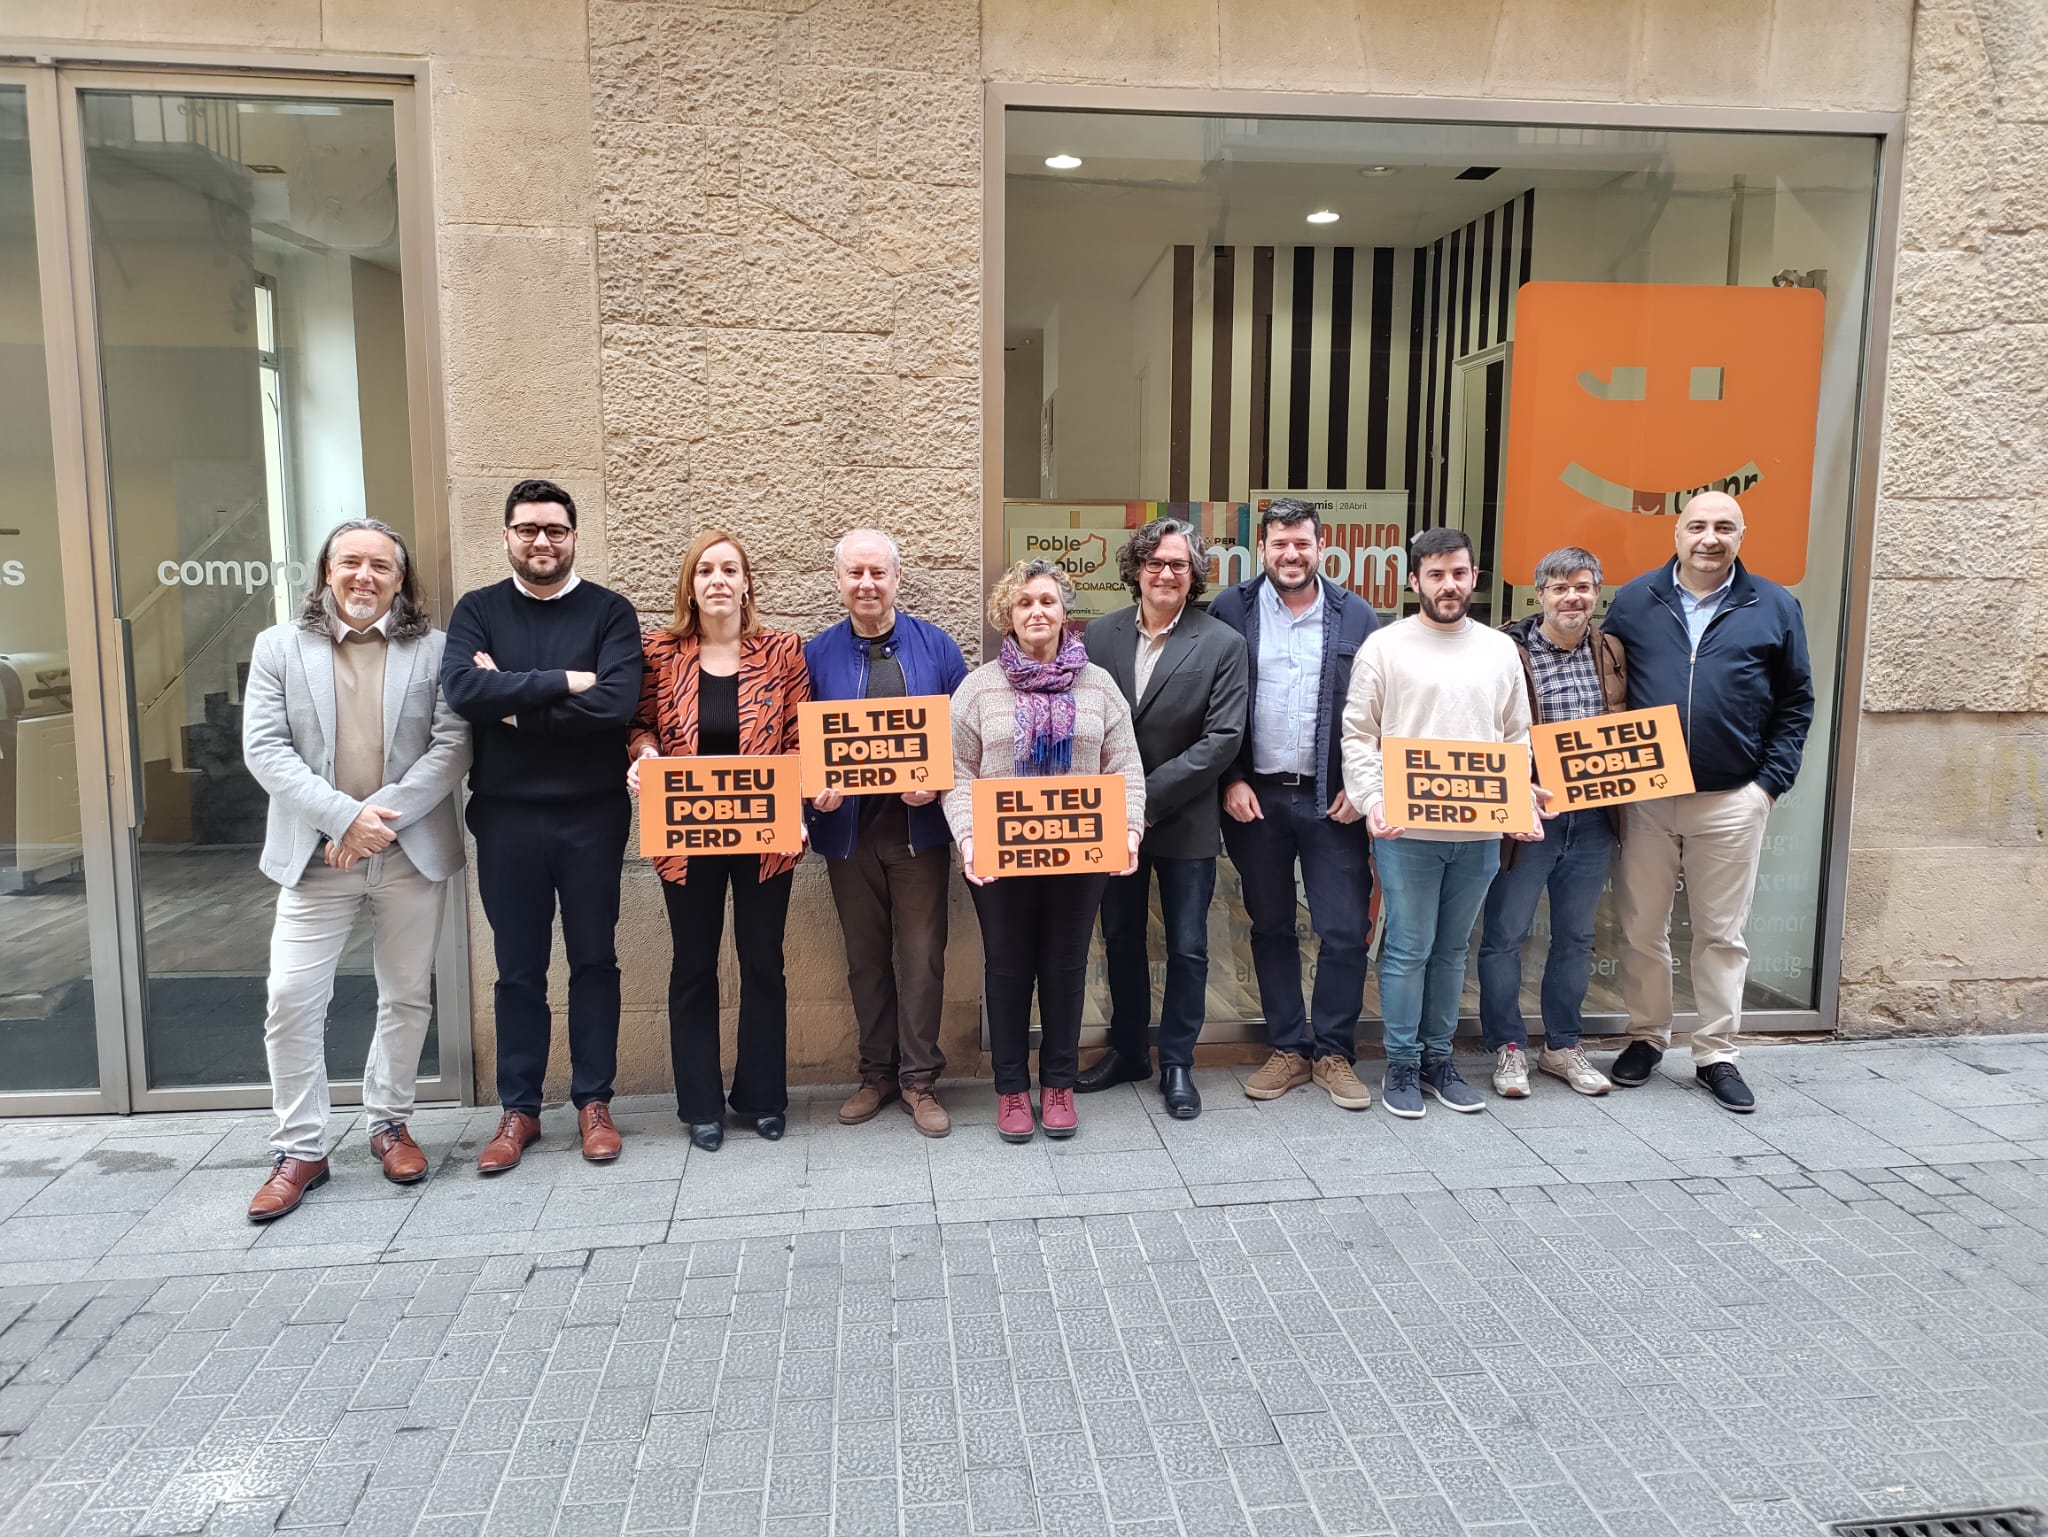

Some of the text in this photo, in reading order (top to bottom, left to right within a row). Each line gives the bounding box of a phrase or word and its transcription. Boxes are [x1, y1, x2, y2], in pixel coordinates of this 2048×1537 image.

[1026, 535, 1081, 551] Poble
[1214, 537, 1236, 545] PER
[0, 559, 26, 586] s
[157, 559, 313, 595] compro
[1318, 545, 1408, 586] om
[1075, 582, 1126, 591] COMARCA
[822, 708, 927, 734] EL TEU
[1555, 719, 1658, 754] EL TEU
[831, 738, 921, 763] POBLE
[1405, 749, 1506, 773] EL TEU
[1566, 747, 1658, 778] POBLE
[663, 768, 775, 792] EL TEU
[825, 767, 896, 789] PERD
[1413, 777, 1500, 799] POBLE
[996, 787, 1101, 813] EL TEU
[1565, 777, 1636, 804] PERD
[673, 798, 768, 821] POBLE
[1408, 803, 1477, 823] PERD
[666, 828, 741, 849] PERD
[1004, 817, 1096, 841] POBLE
[998, 847, 1070, 869] PERD
